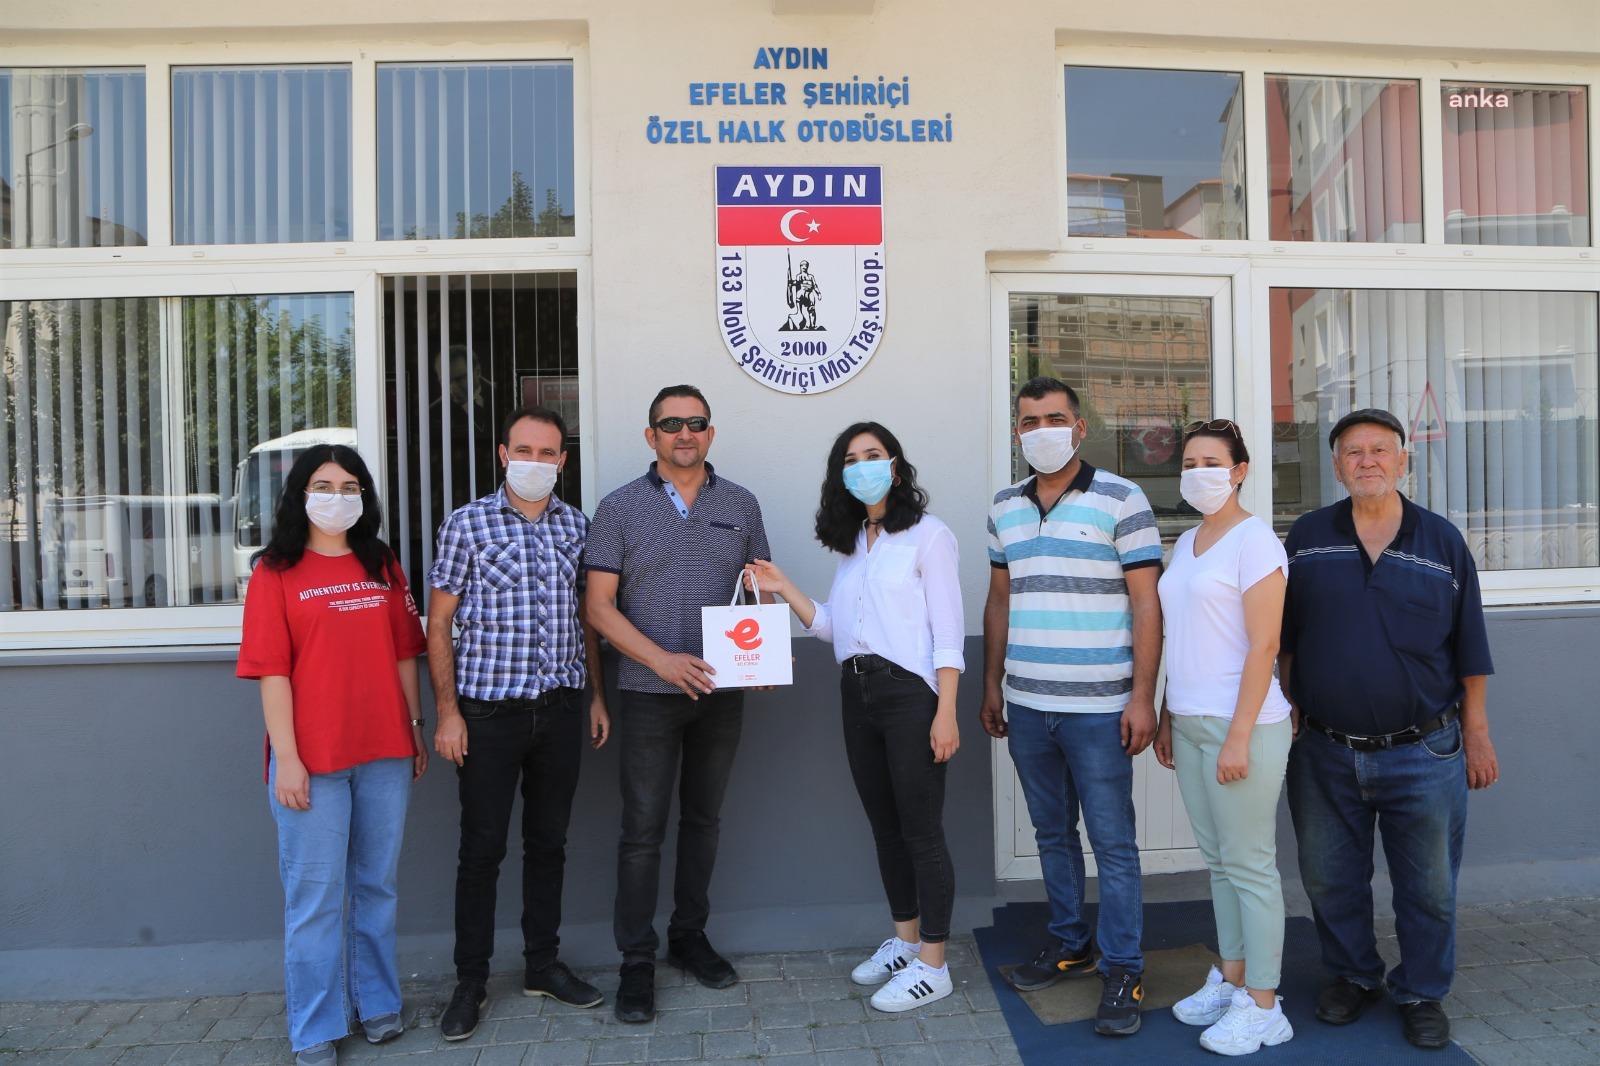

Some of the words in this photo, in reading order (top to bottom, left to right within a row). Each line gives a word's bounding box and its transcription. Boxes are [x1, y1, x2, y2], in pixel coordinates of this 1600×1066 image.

[753, 47, 828, 70] AYDIN
[689, 82, 787, 106] EFELER
[803, 76, 910, 108] ŞEHİRİÇİ
[646, 115, 711, 144] ÖZEL
[718, 120, 786, 143] HALK
[797, 113, 953, 143] OTOBÜSLERİ
[732, 173, 867, 198] AYDIN
[721, 252, 743, 293] 133
[722, 301, 747, 348] Nolu
[780, 341, 828, 357] 2000
[738, 345, 816, 393] Şehiriçi
[299, 584, 351, 601] AUTHENTICITY
[352, 582, 361, 591] IS
